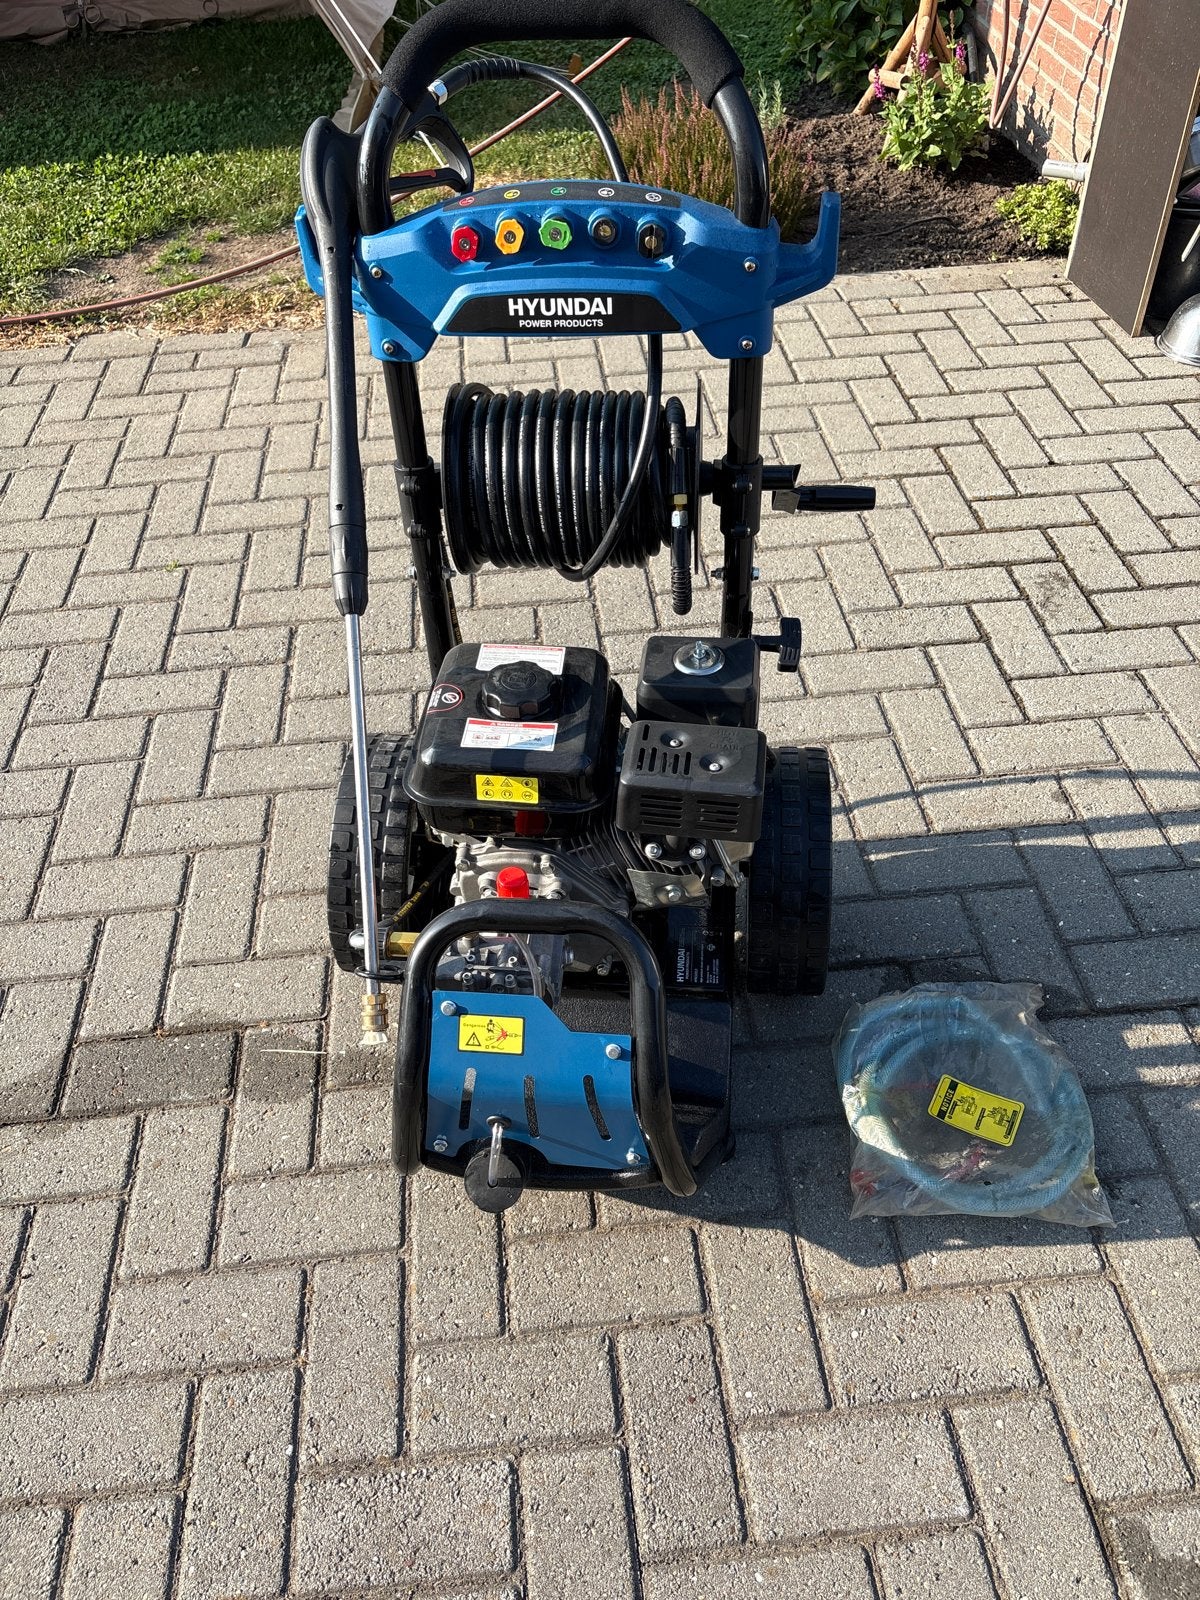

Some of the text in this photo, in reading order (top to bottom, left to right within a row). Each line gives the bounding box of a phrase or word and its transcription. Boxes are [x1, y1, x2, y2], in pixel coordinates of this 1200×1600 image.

[508, 297, 613, 316] HYUNDAI
[519, 319, 604, 328] POWER PRODUCTS
[677, 948, 685, 982] HYUNDAI
[941, 1088, 955, 1112] NOTICE
